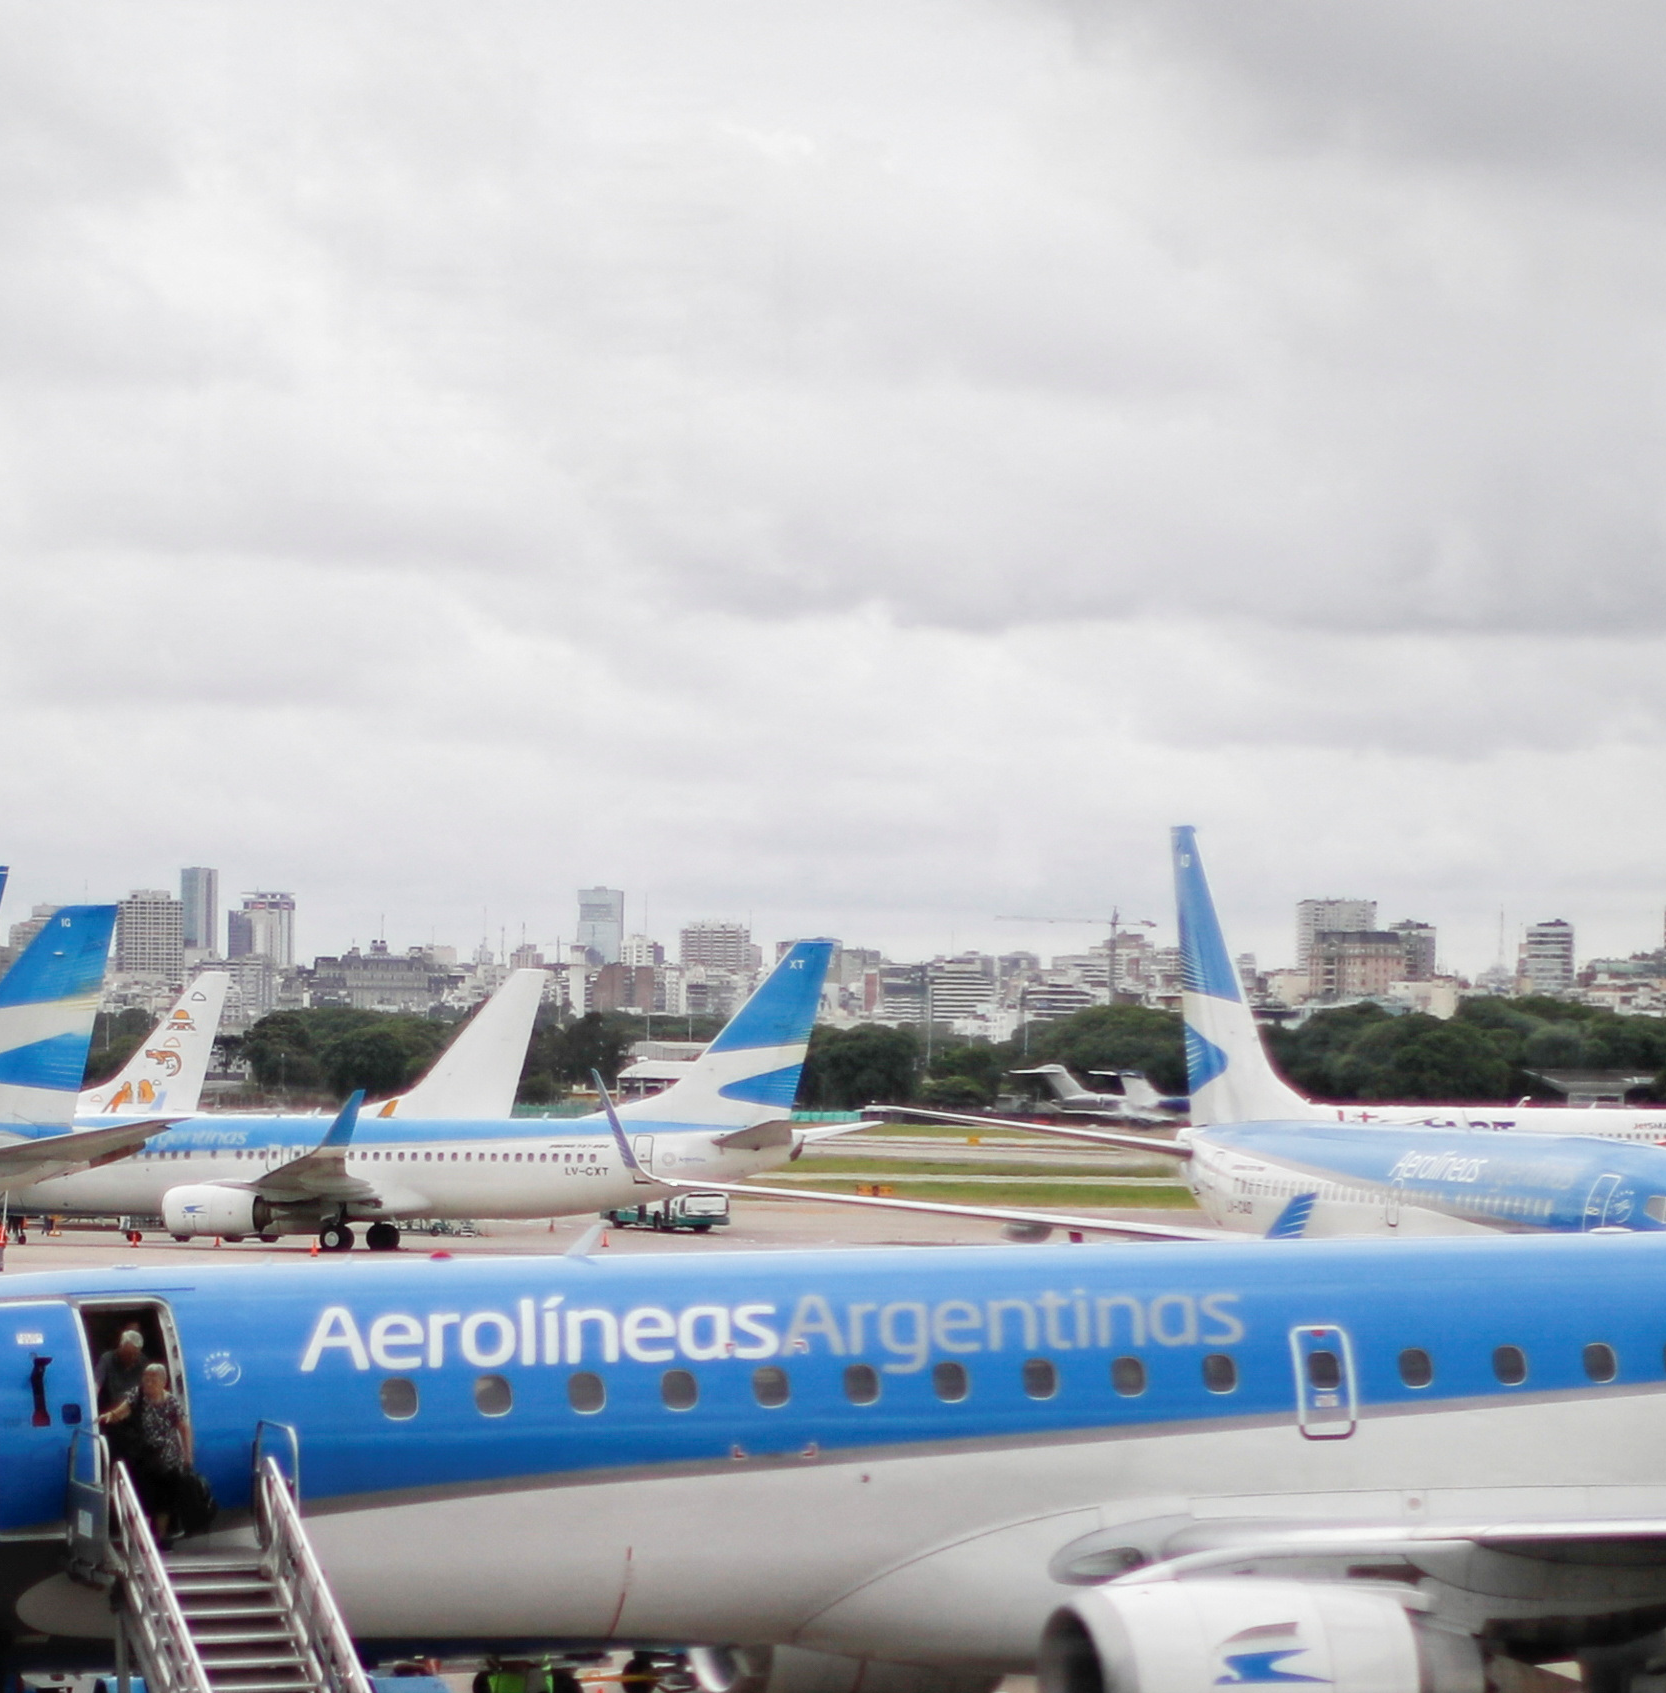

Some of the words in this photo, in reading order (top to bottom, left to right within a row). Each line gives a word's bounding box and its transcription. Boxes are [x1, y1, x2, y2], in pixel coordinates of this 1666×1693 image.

[60, 918, 71, 928] IG
[789, 960, 805, 970] XT
[564, 1166, 610, 1177] LV-CXT
